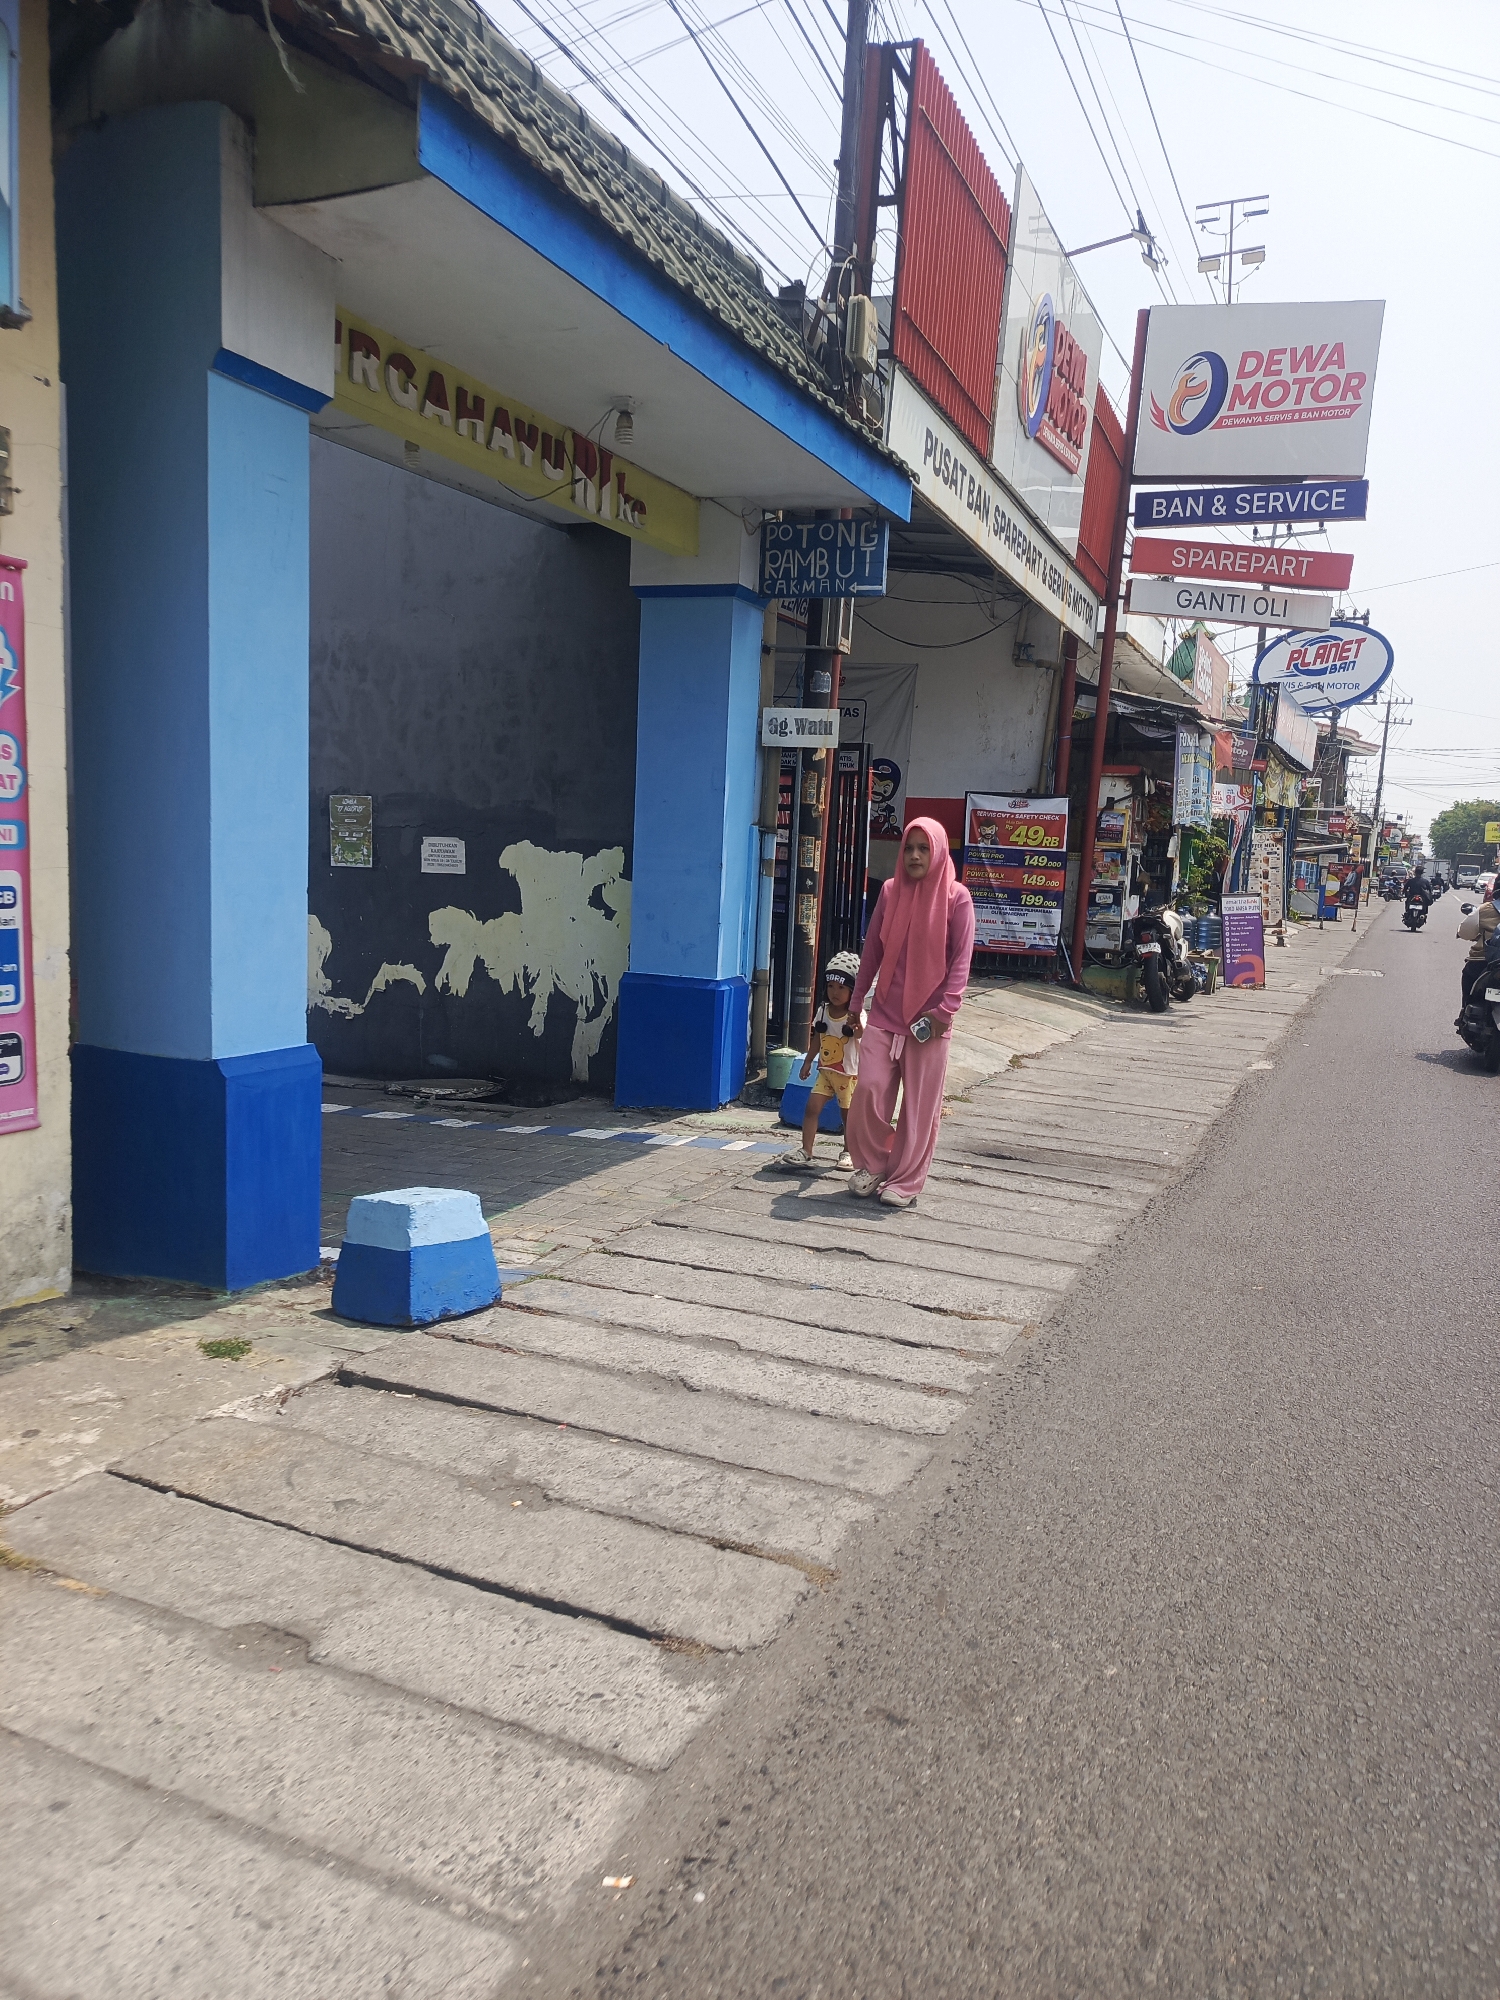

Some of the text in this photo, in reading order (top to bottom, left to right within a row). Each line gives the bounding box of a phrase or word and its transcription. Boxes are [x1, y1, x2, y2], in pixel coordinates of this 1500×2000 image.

[1053, 320, 1087, 398] DEWA
[1236, 342, 1346, 380] DEWA
[1227, 371, 1366, 412] MOTOR
[334, 318, 565, 481] RGAHAYU
[570, 431, 614, 521] RI
[1046, 368, 1087, 450] MOTOR
[1221, 408, 1351, 426] DEWANYA SERVIS & BAN MOTOR
[1152, 489, 1347, 519] BAN & SERVICE
[765, 521, 879, 549] POTONG
[923, 427, 1094, 629] PUSAT BAN, SPAREPART & SERVIS MOTOR
[764, 547, 876, 579] RAMBUT
[1171, 547, 1314, 578] SPAREPART
[1176, 589, 1288, 618] GANTI OLI
[1285, 637, 1367, 671] PLANET
[1328, 660, 1356, 675] BAN
[1326, 682, 1360, 691] MOTOR
[976, 810, 996, 818] SERVIS
[1009, 825, 1045, 846] 49
[1042, 837, 1060, 847] RB
[1024, 855, 1061, 867] 149.000
[966, 870, 988, 878] POWER
[1022, 874, 1060, 887] 149.000
[1020, 894, 1057, 907] 199.000
